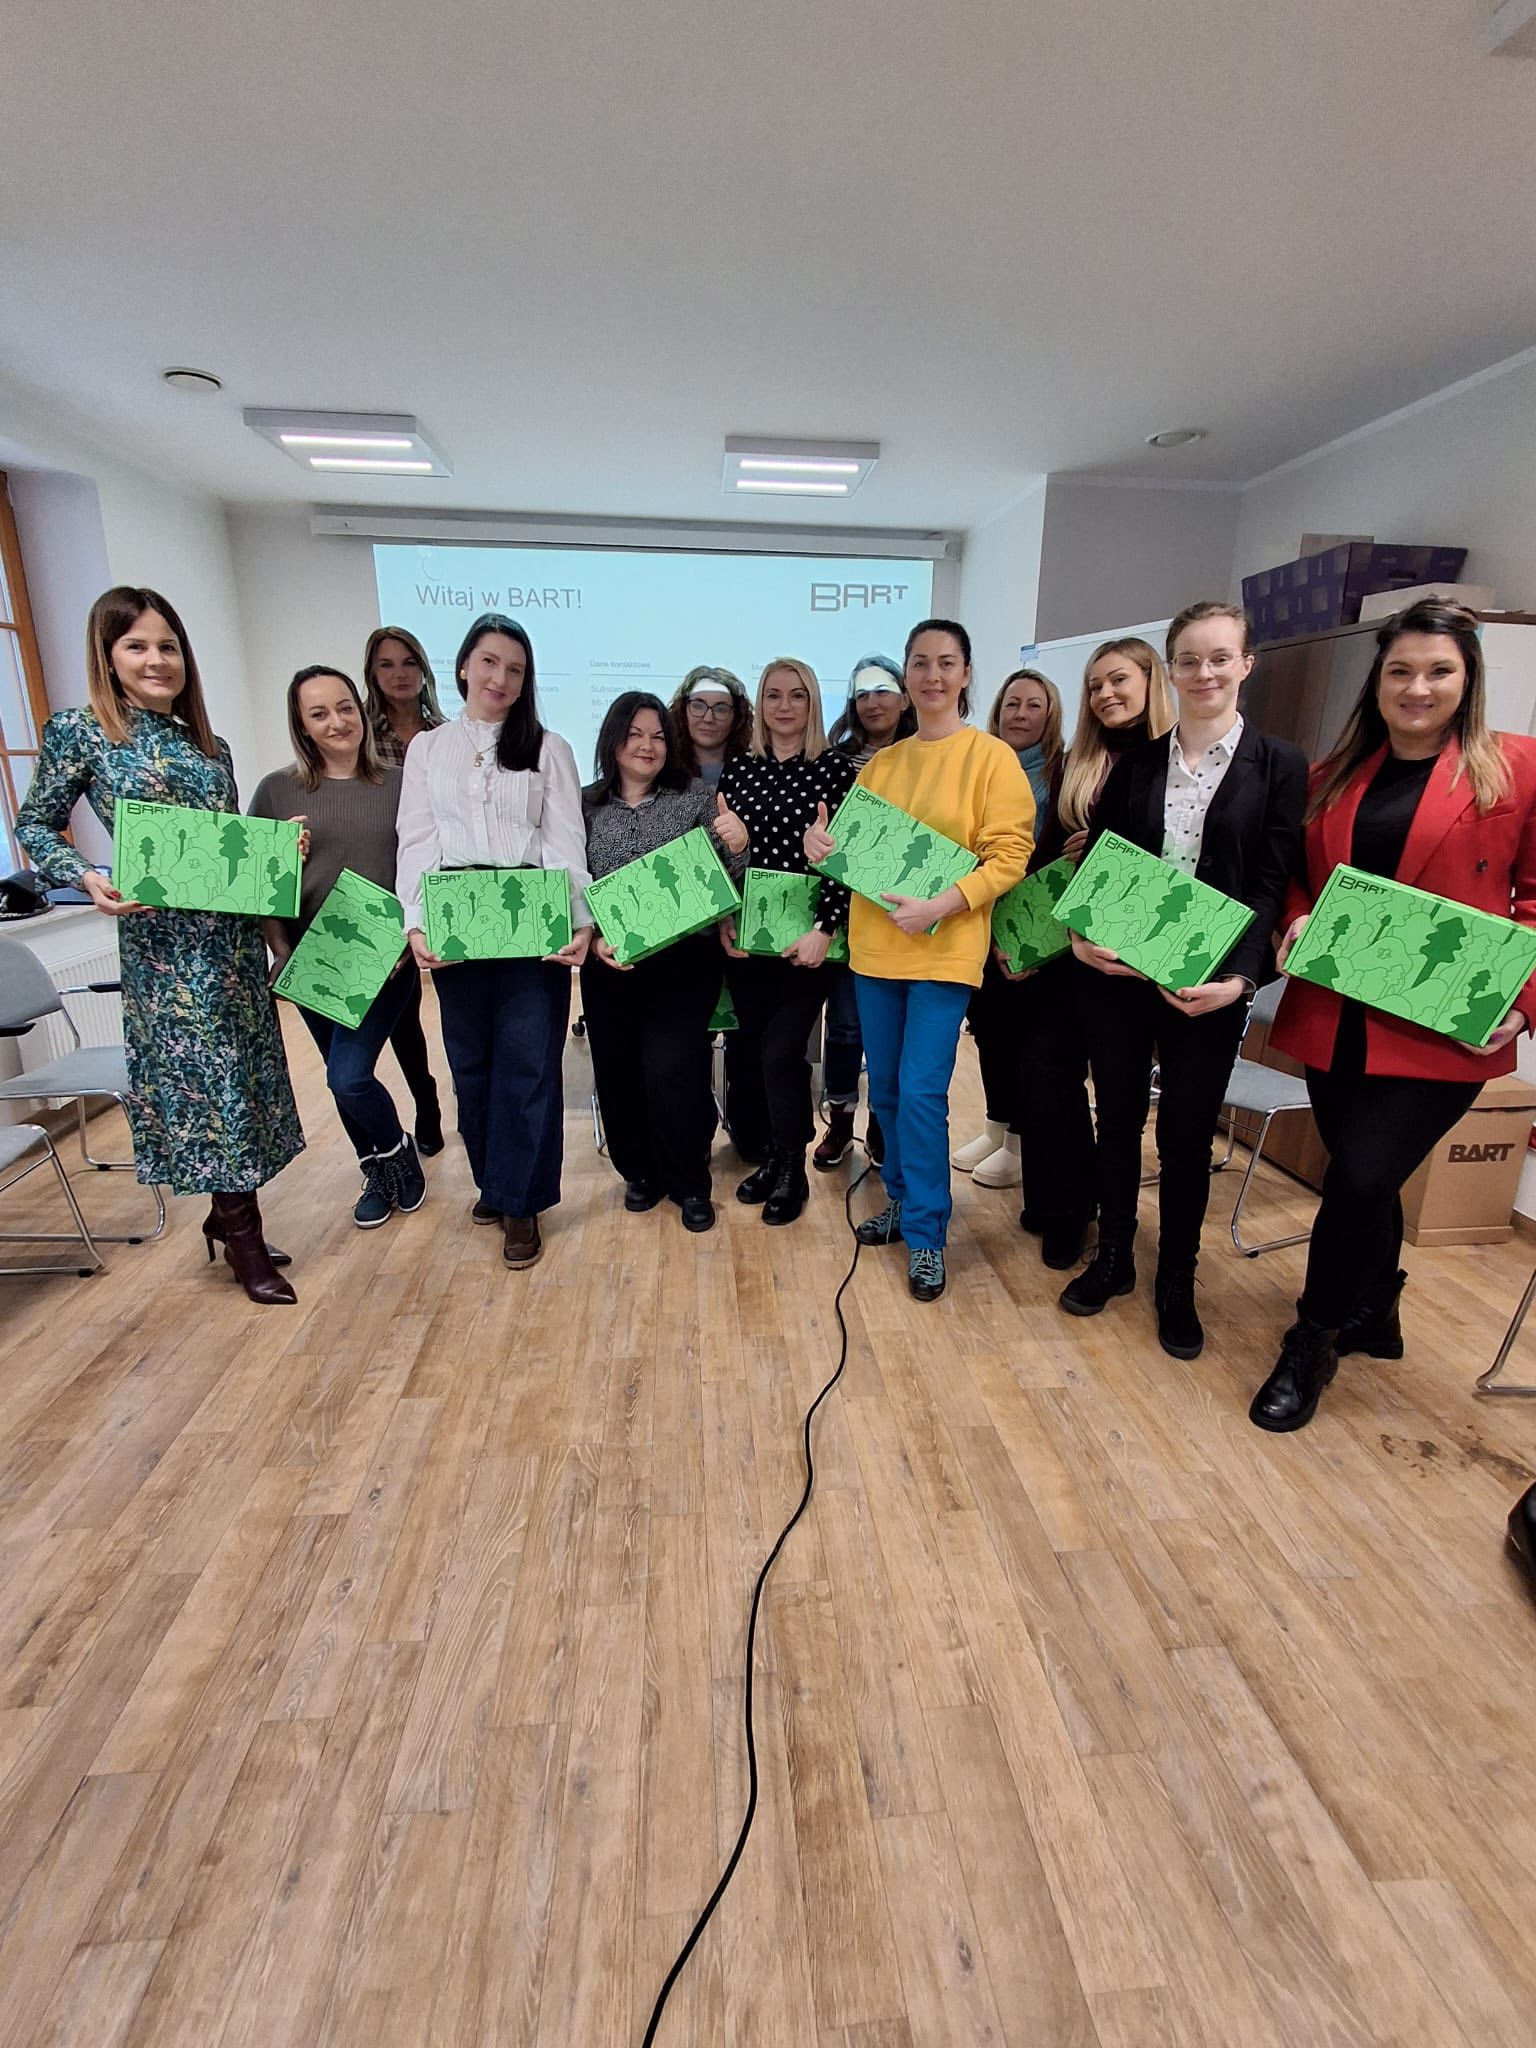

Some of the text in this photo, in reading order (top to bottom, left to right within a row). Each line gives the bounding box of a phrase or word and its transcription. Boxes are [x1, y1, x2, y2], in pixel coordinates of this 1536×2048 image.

[415, 584, 582, 611] Witaj w BART!
[810, 583, 909, 611] BART
[855, 789, 887, 808] BART
[127, 803, 171, 815] BART
[1105, 836, 1141, 857] BART
[428, 874, 462, 885] BART
[751, 870, 779, 880] BART
[1338, 875, 1388, 895] BART
[589, 875, 616, 896] BART
[278, 958, 298, 990] BART
[1447, 1143, 1516, 1163] BART
